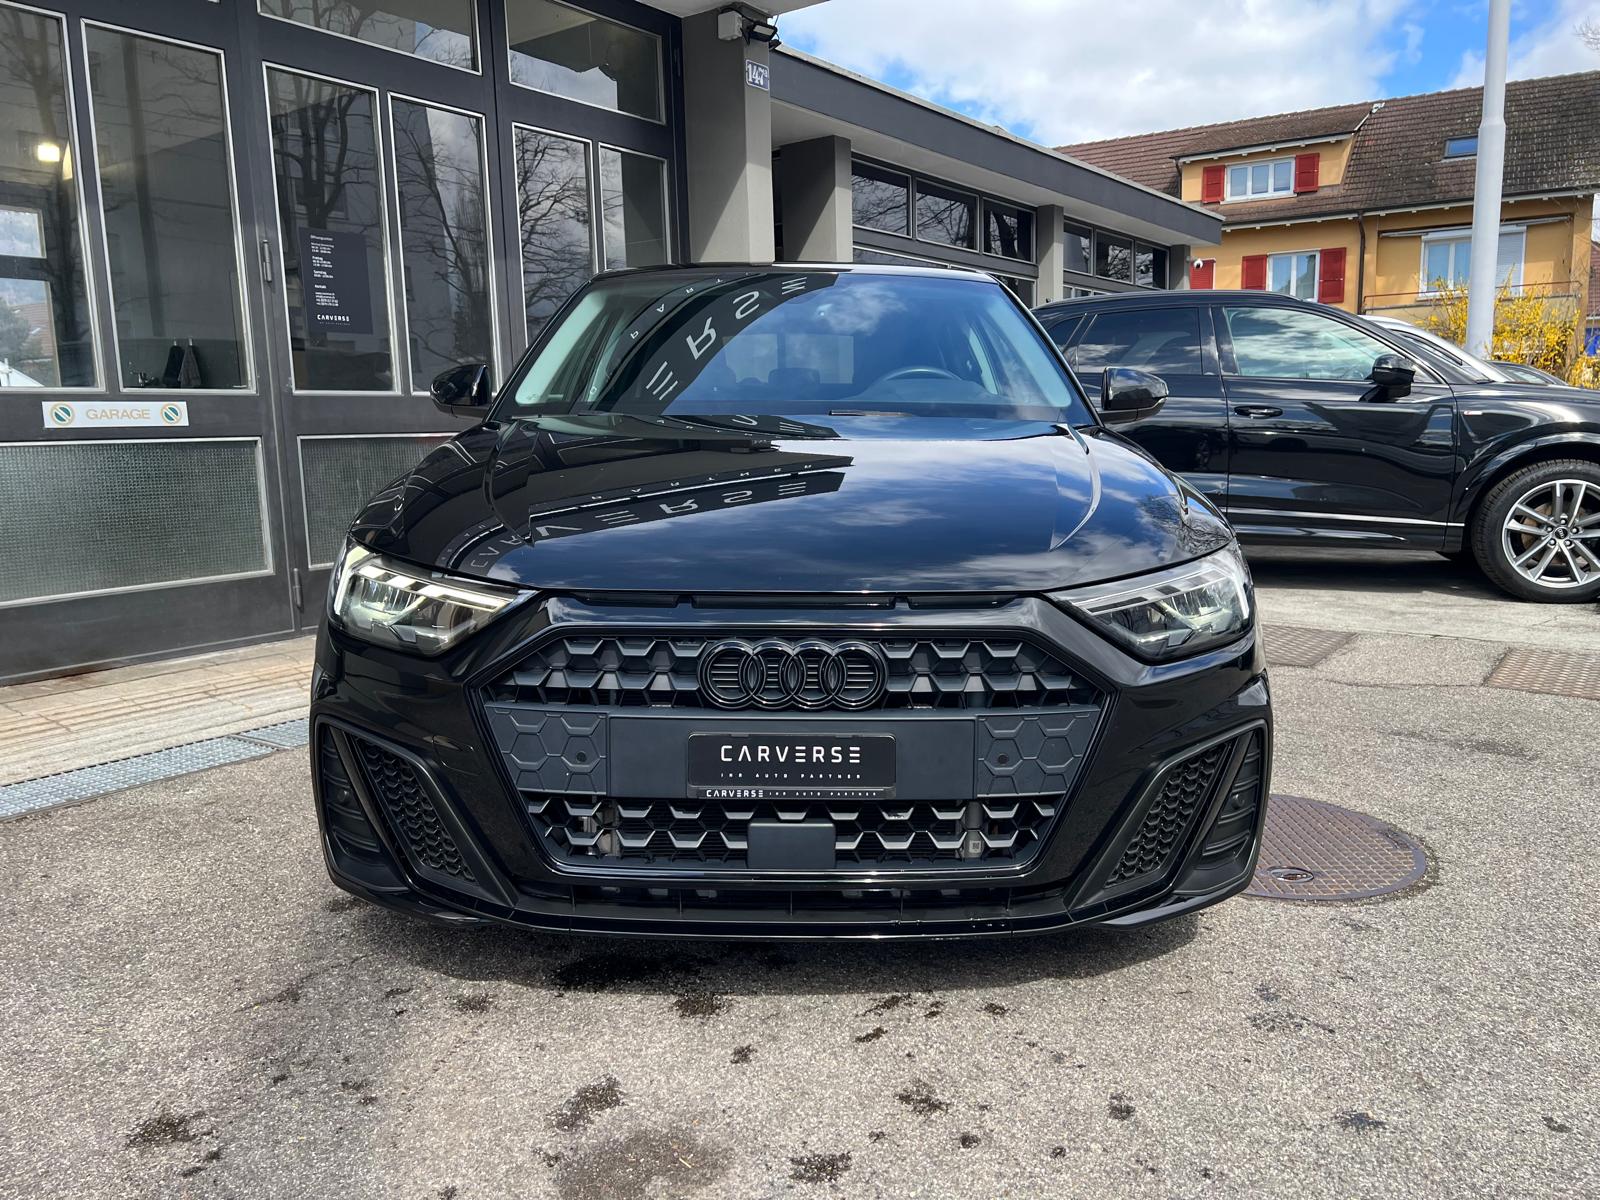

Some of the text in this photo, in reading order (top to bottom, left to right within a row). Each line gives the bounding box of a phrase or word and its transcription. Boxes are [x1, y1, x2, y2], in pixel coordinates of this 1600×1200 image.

[86, 408, 151, 420] GARAGE
[720, 745, 861, 763] CARVERSE
[706, 789, 764, 798] CARVERSE
